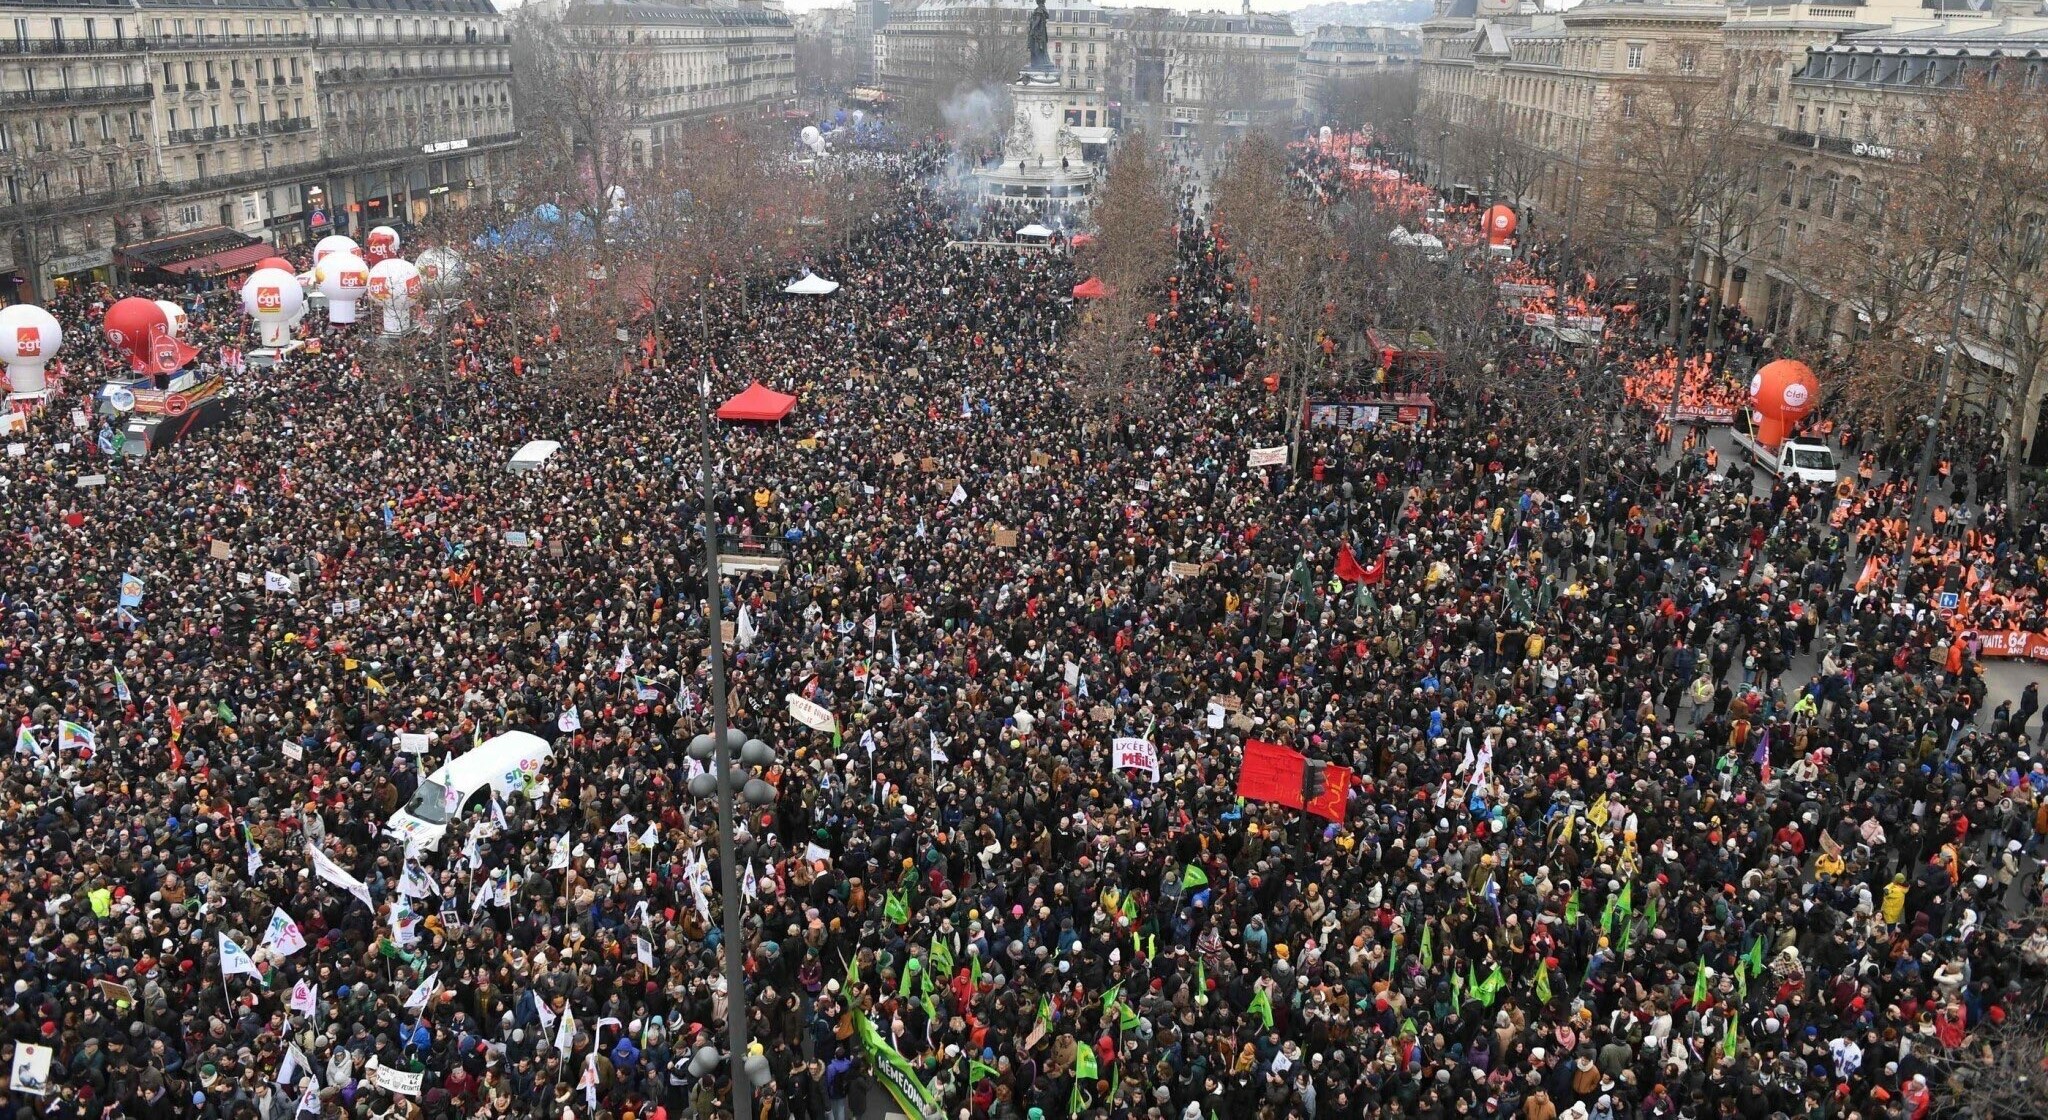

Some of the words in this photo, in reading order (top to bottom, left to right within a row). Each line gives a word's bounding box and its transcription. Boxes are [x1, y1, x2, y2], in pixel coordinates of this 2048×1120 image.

[341, 277, 358, 287] cgt
[258, 293, 281, 307] cgt
[18, 338, 41, 352] cgt
[2008, 632, 2028, 648] 64
[505, 758, 538, 784] snes
[878, 1055, 904, 1088] MÊME
